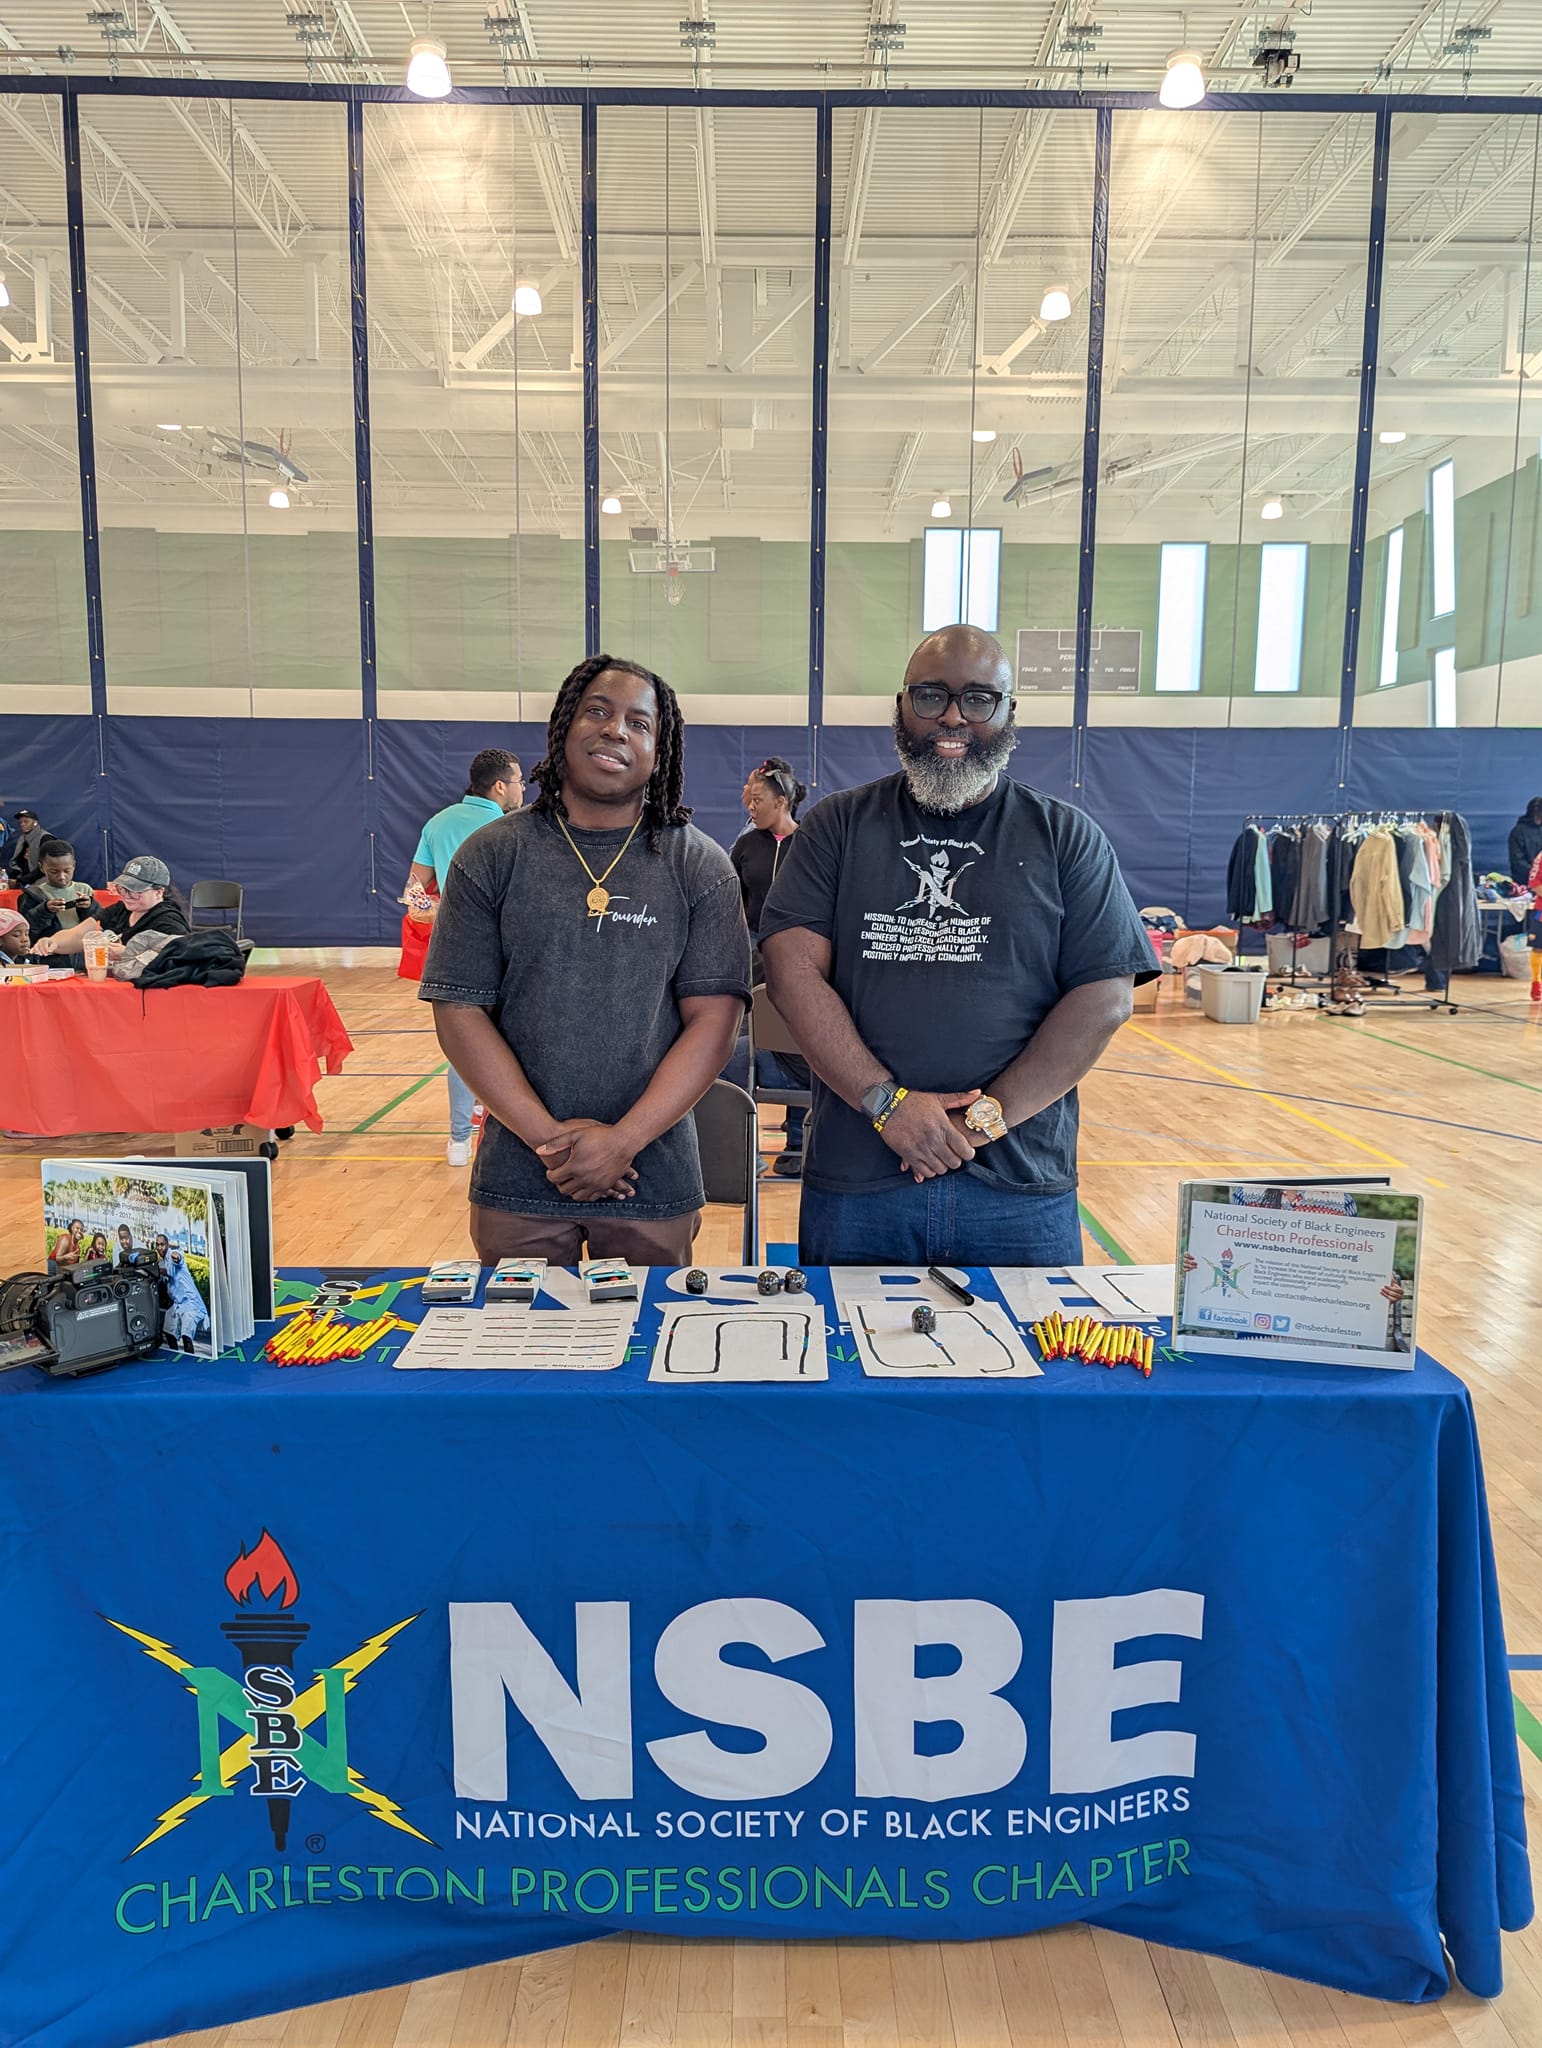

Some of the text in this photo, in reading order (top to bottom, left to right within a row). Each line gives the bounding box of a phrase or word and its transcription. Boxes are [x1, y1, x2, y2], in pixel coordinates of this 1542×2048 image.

[871, 922, 914, 936] CULTURALLY
[957, 926, 981, 936] BLACK
[897, 915, 907, 925] TO
[949, 917, 980, 927] NUMBER
[981, 916, 992, 925] OF
[860, 930, 899, 942] ENGINEERS
[899, 934, 914, 945] WHO
[914, 934, 935, 946] EXCEL
[862, 949, 899, 961] POSITIVELY
[899, 952, 924, 962] IMPACT
[924, 953, 937, 962] THE
[871, 941, 902, 952] SUCCEED
[960, 944, 976, 953] AND
[1204, 1209, 1386, 1239] National Society of Black Engineers
[1216, 1224, 1374, 1253] Charleston Professionals
[1233, 1241, 1358, 1263] www.nsbecharleston.org
[1212, 1313, 1249, 1326] facebook
[1294, 1321, 1362, 1338] @nsbecharleston
[448, 1588, 1205, 1802] NSBE
[455, 1786, 1191, 1840] NATIONAL SOCIETY OF BLACK ENGINEERS
[114, 1837, 1192, 1935] CHARLESTON PROFESSIONALS CHAPTER
